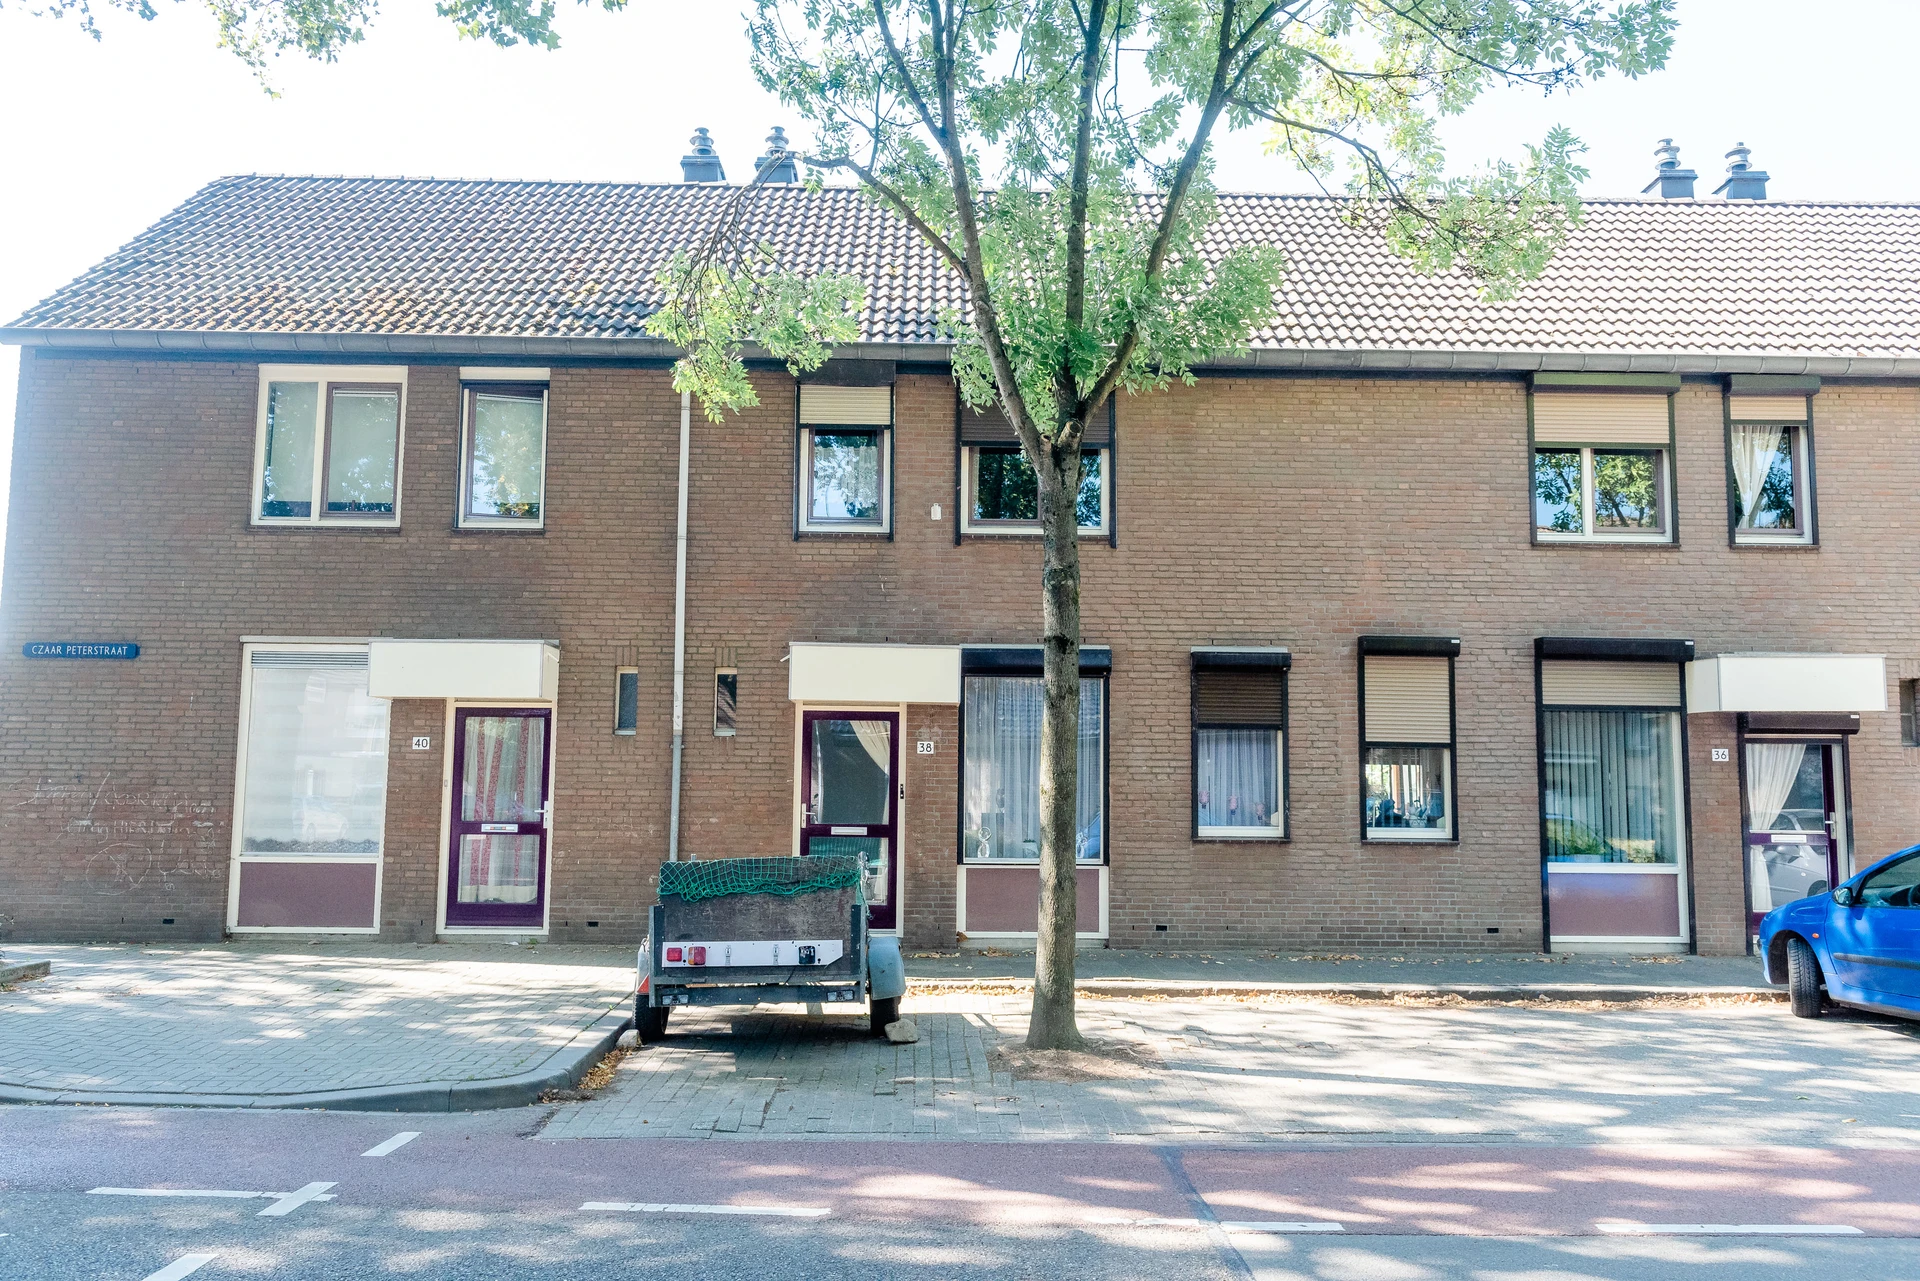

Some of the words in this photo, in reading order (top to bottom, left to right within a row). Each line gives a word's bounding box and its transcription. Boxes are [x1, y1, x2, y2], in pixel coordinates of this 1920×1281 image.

[31, 645, 62, 655] CZAAR
[66, 645, 128, 655] PETERSTRAAT
[414, 738, 428, 748] 40
[919, 742, 932, 753] 38
[1714, 750, 1727, 760] 36
